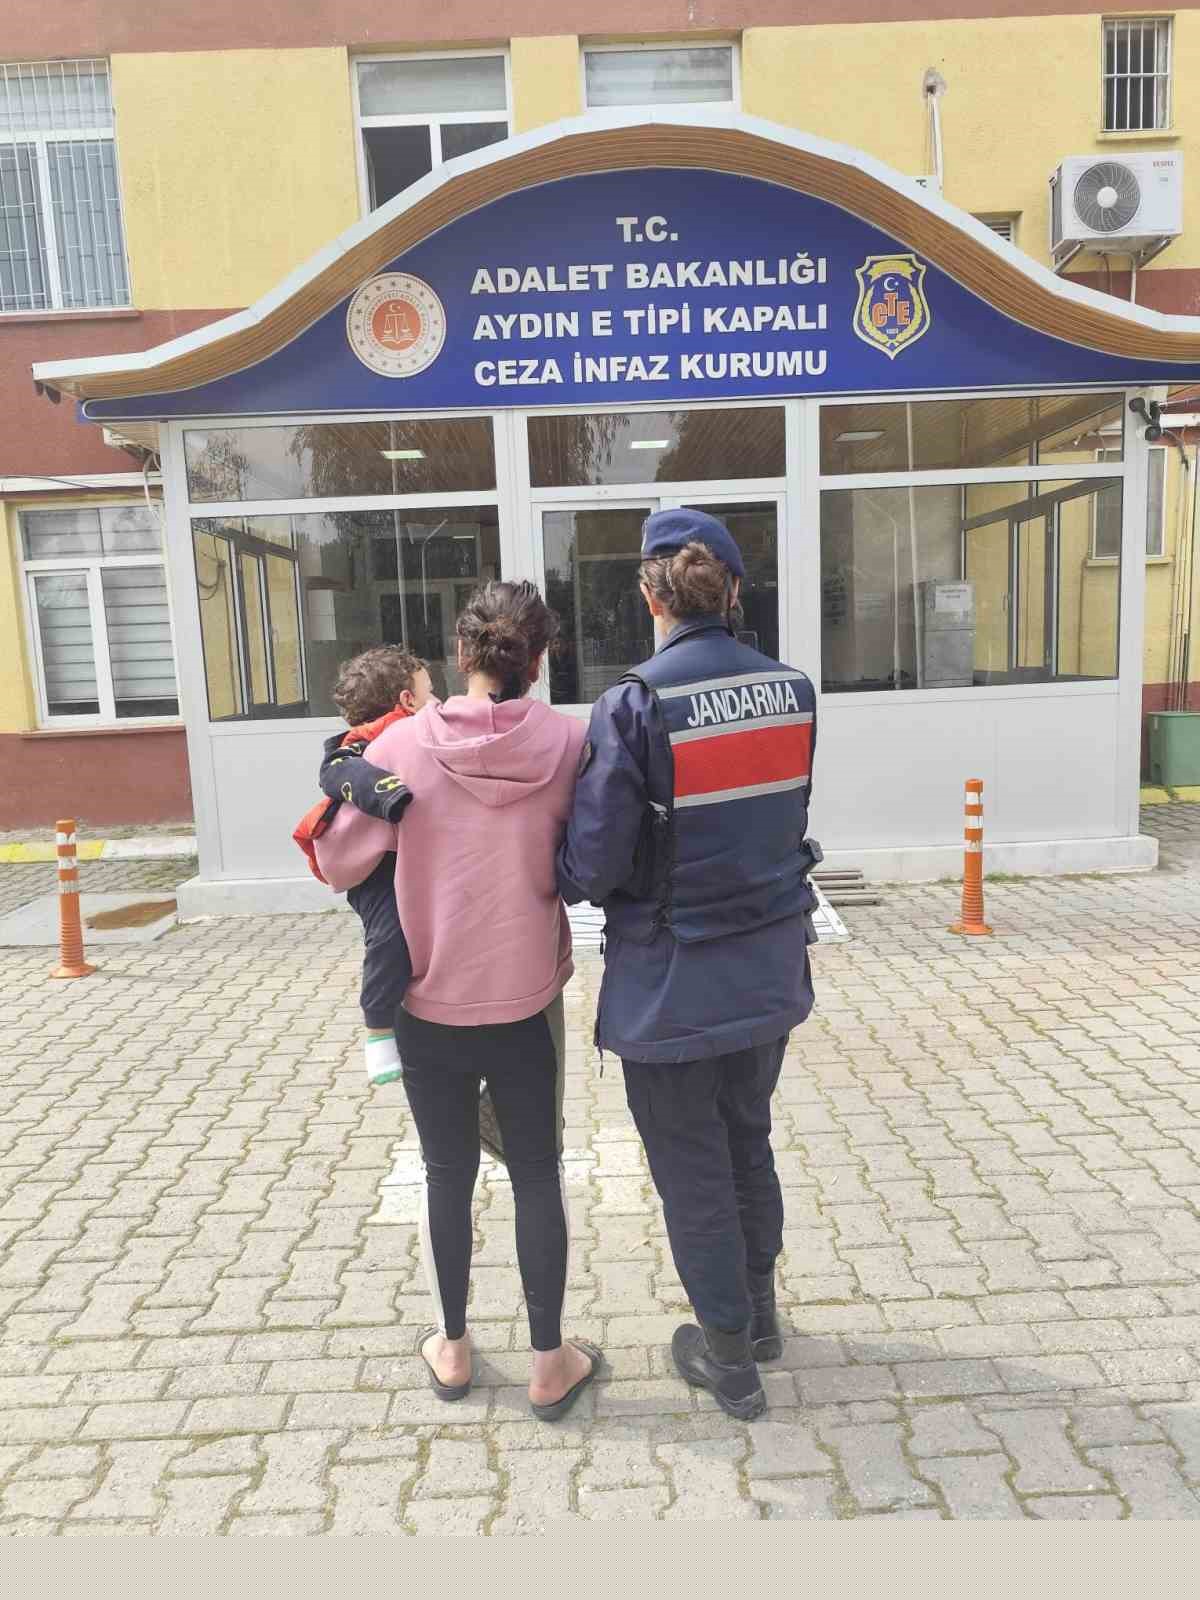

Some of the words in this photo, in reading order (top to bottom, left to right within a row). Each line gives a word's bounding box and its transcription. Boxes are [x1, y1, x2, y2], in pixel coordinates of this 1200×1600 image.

[615, 215, 679, 243] T.C.
[470, 264, 614, 295] ADALET
[626, 252, 827, 289] BAKANLIĞI
[473, 311, 579, 341] AYDIN
[591, 310, 613, 337] E
[623, 302, 691, 336] TİPİ
[703, 303, 827, 334] KAPALI
[474, 358, 564, 387] CEZA
[573, 351, 670, 384] İNFAZ
[680, 350, 828, 380] KURUMU
[687, 681, 800, 728] JANDARMA
